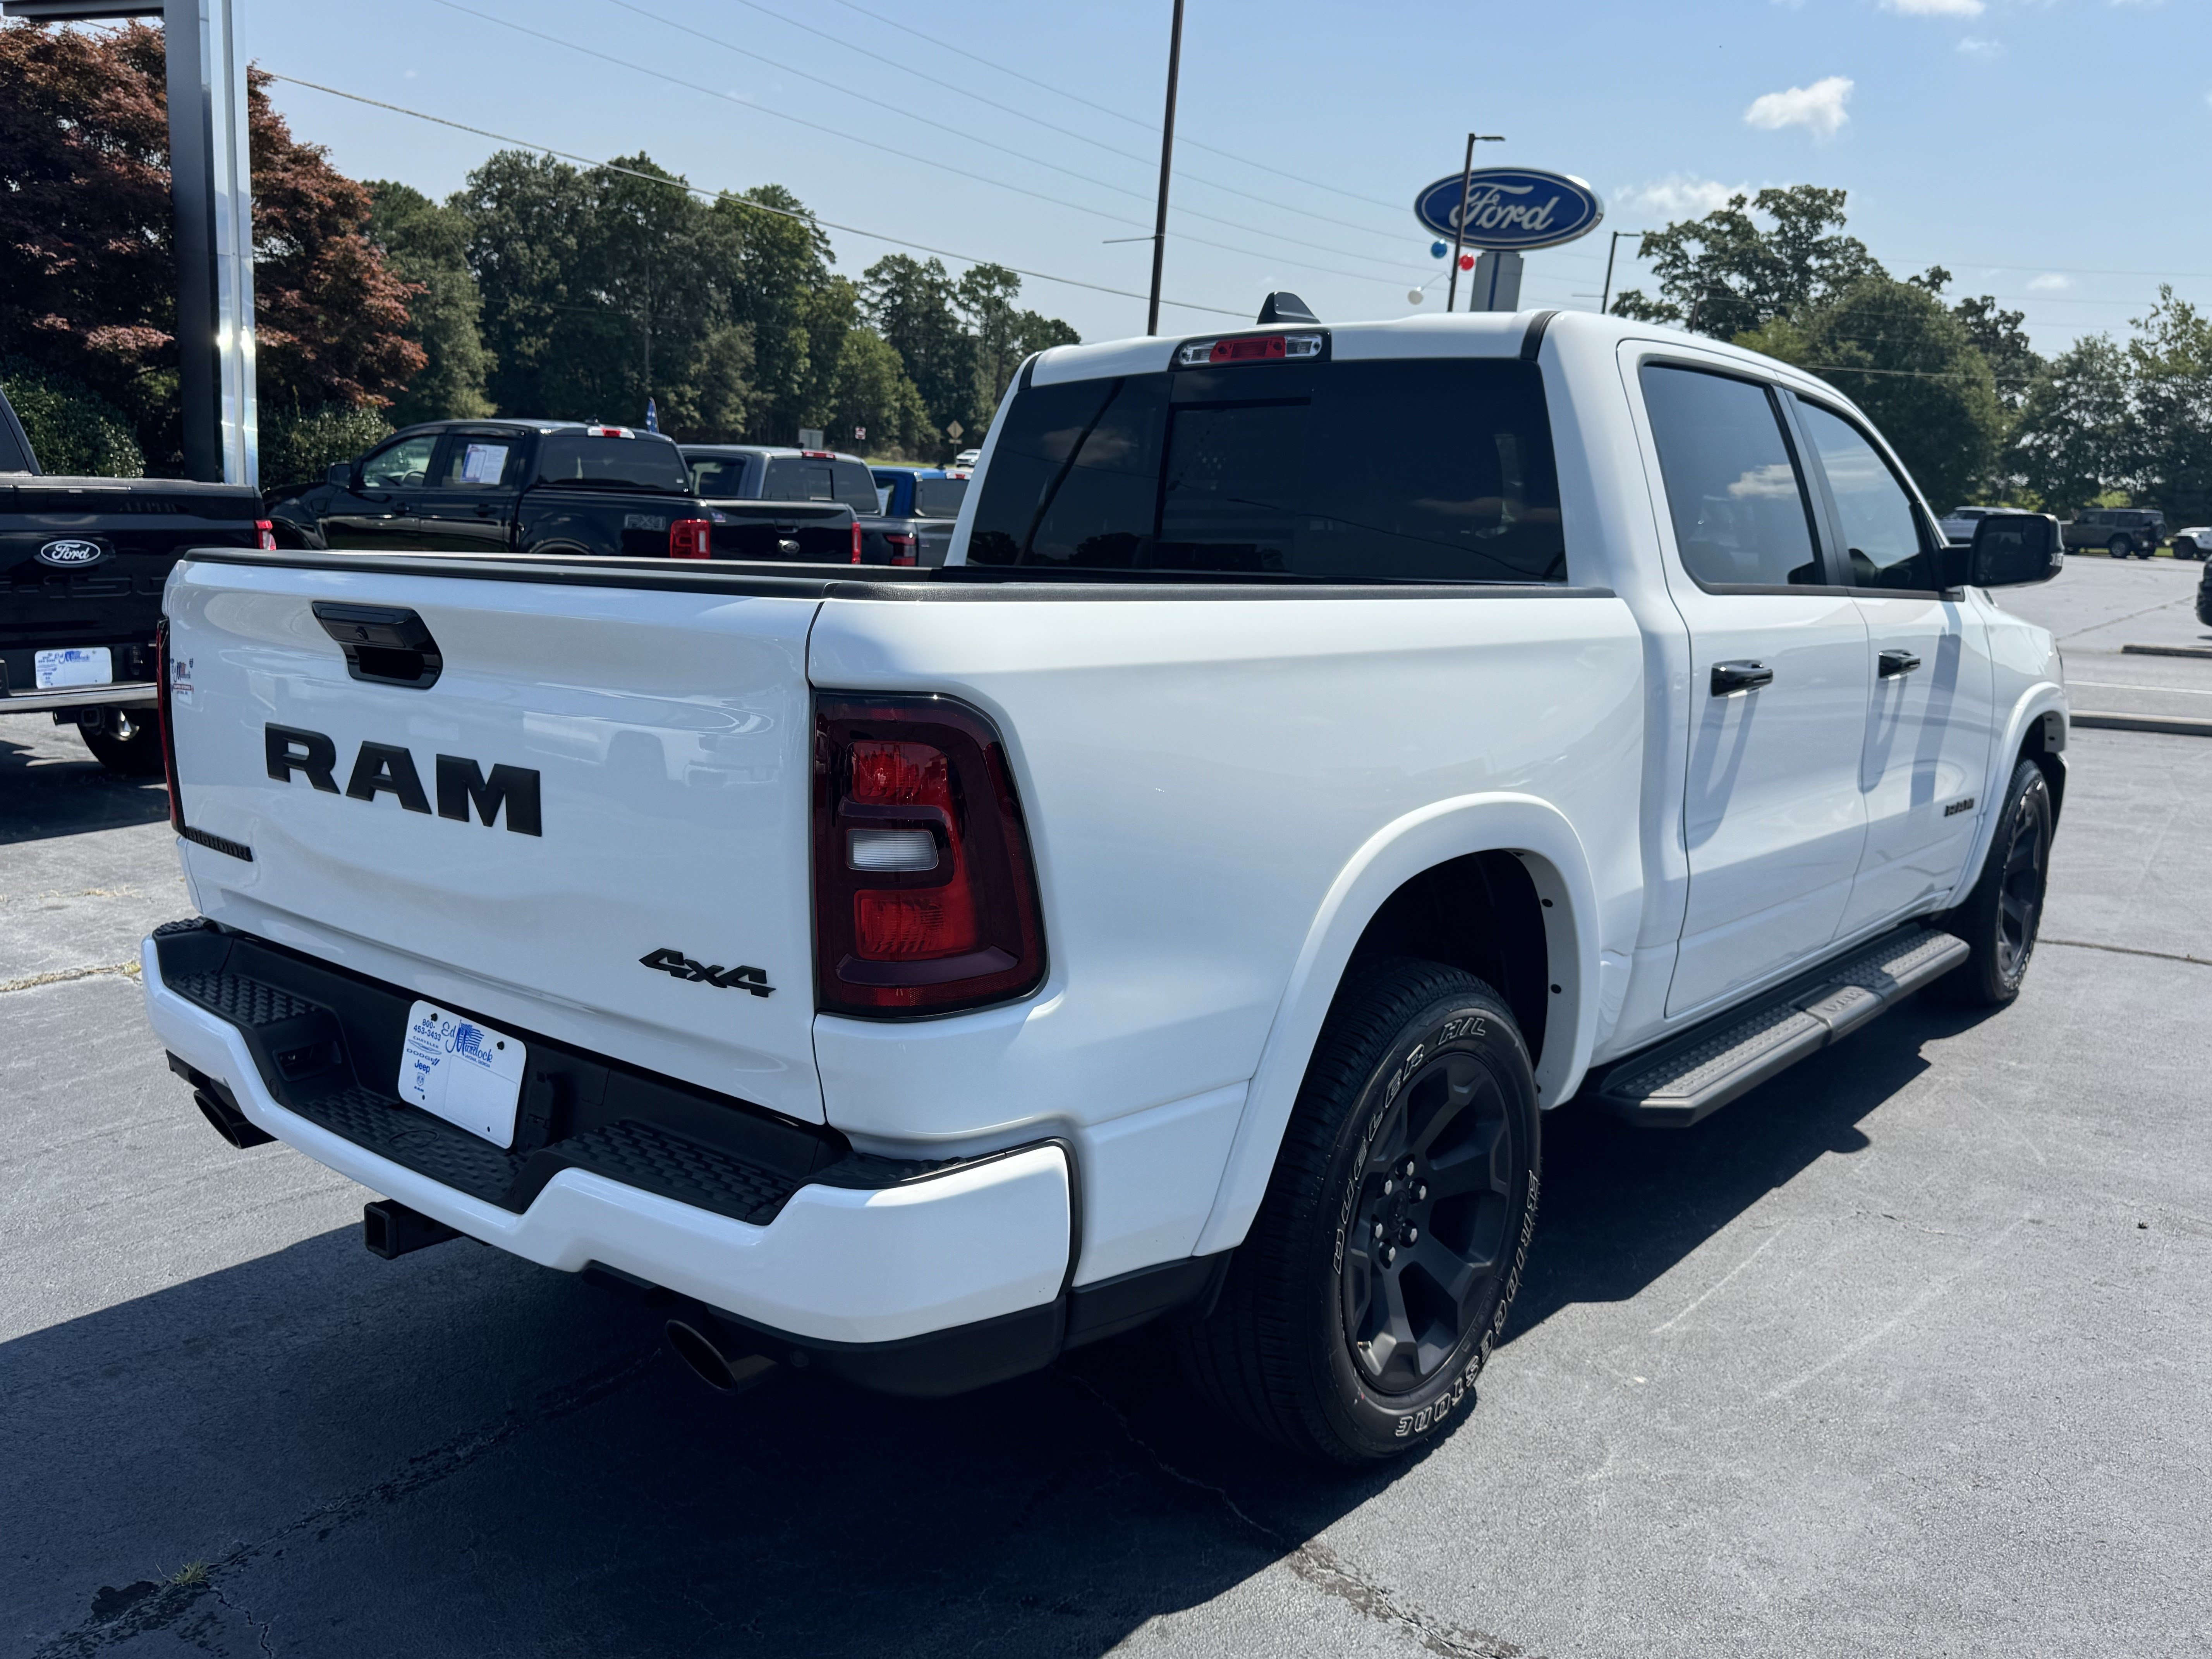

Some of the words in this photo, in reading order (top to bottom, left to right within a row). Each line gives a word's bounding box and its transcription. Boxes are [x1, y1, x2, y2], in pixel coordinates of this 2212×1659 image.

[1449, 182, 1560, 230] Ford
[52, 543, 90, 560] Ford
[265, 722, 542, 837] RAM
[422, 1019, 435, 1029] 800-
[441, 1022, 457, 1038] Ed
[414, 1025, 441, 1041] 453-3433
[413, 1036, 439, 1049] CHRYSLER
[446, 1027, 493, 1063] Murdock
[407, 1048, 436, 1064] DODGE
[415, 1059, 431, 1074] Jeep
[1333, 1043, 1425, 1275] DUELER
[1438, 1017, 1486, 1046] H/L
[1395, 1169, 1540, 1437] BRIDGESTONE
